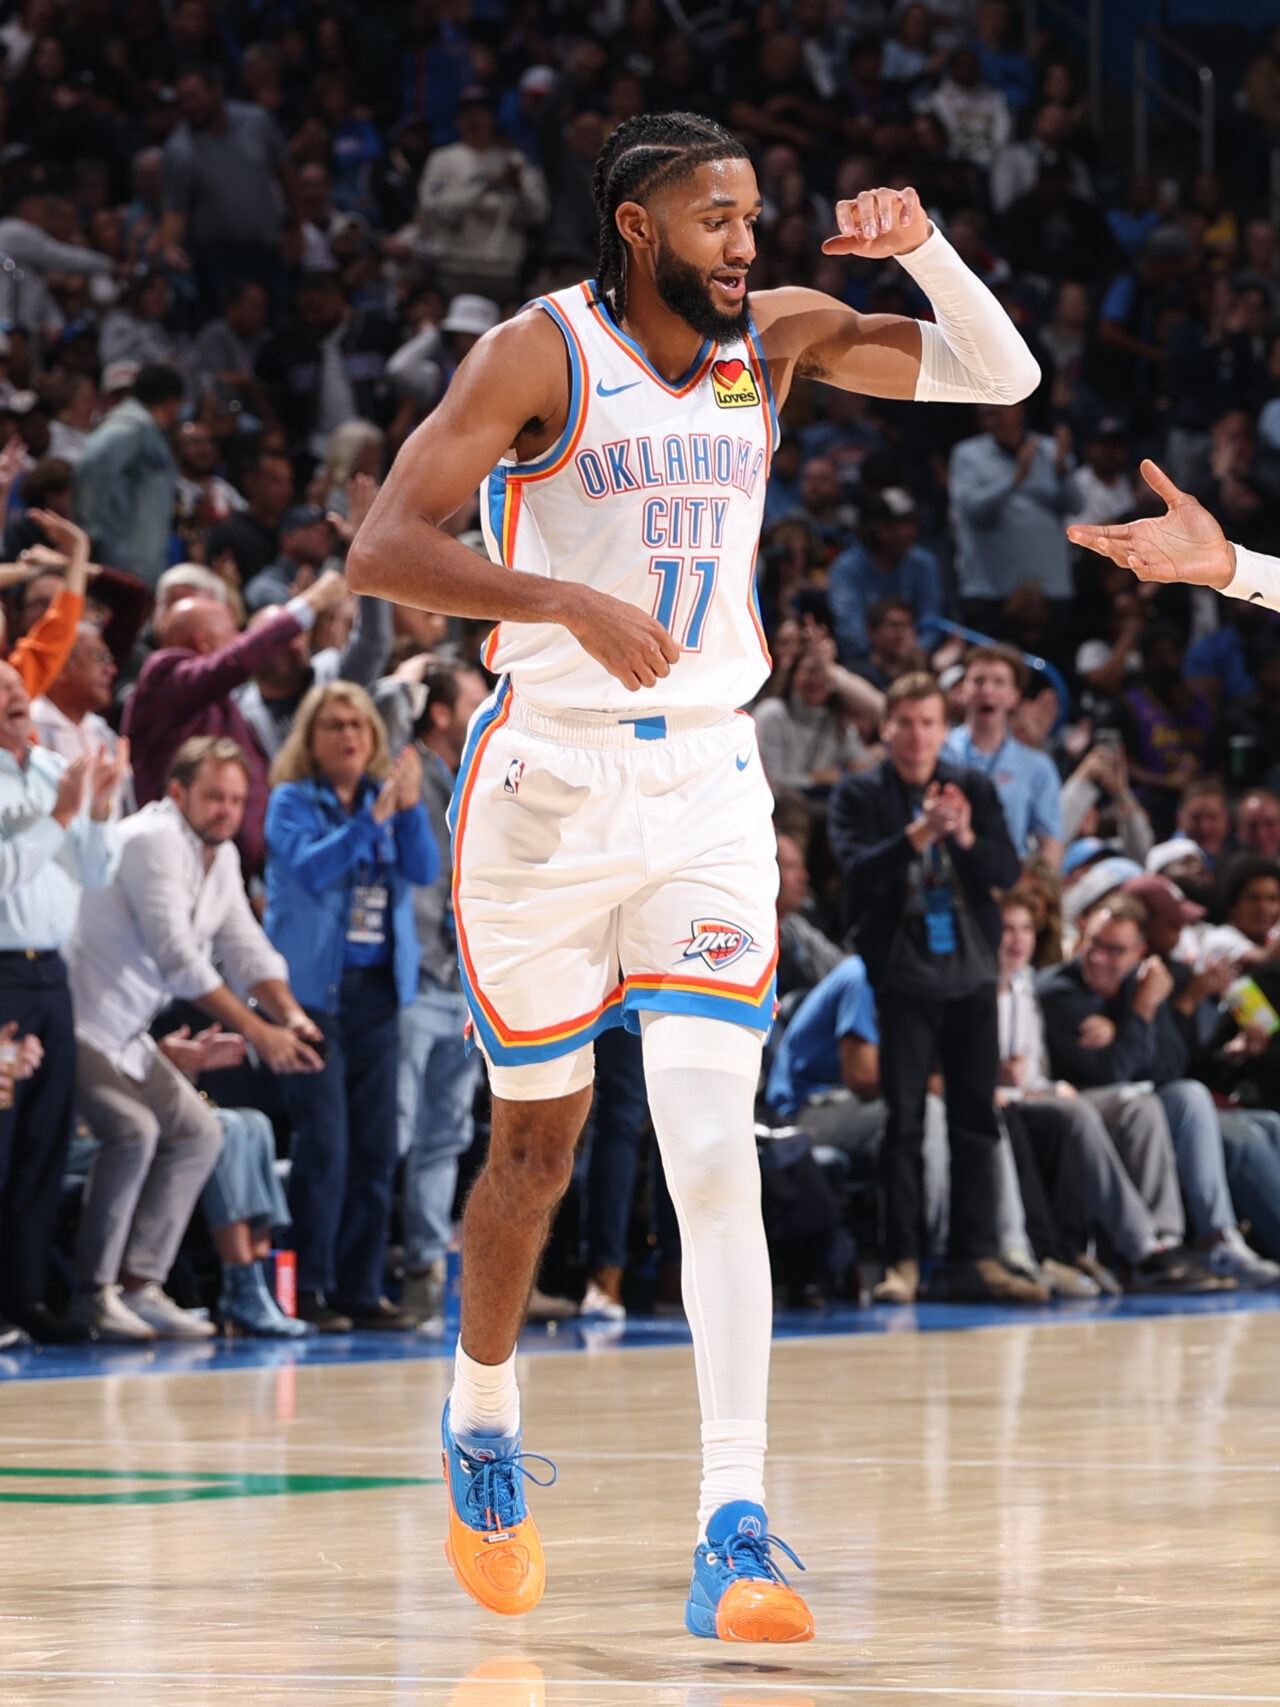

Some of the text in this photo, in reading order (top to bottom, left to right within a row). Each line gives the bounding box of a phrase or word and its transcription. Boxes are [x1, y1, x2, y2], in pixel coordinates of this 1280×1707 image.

[575, 433, 766, 500] OKLAHOMA
[641, 496, 730, 549] CITY
[648, 555, 720, 654] 11
[682, 931, 740, 957] OKC
